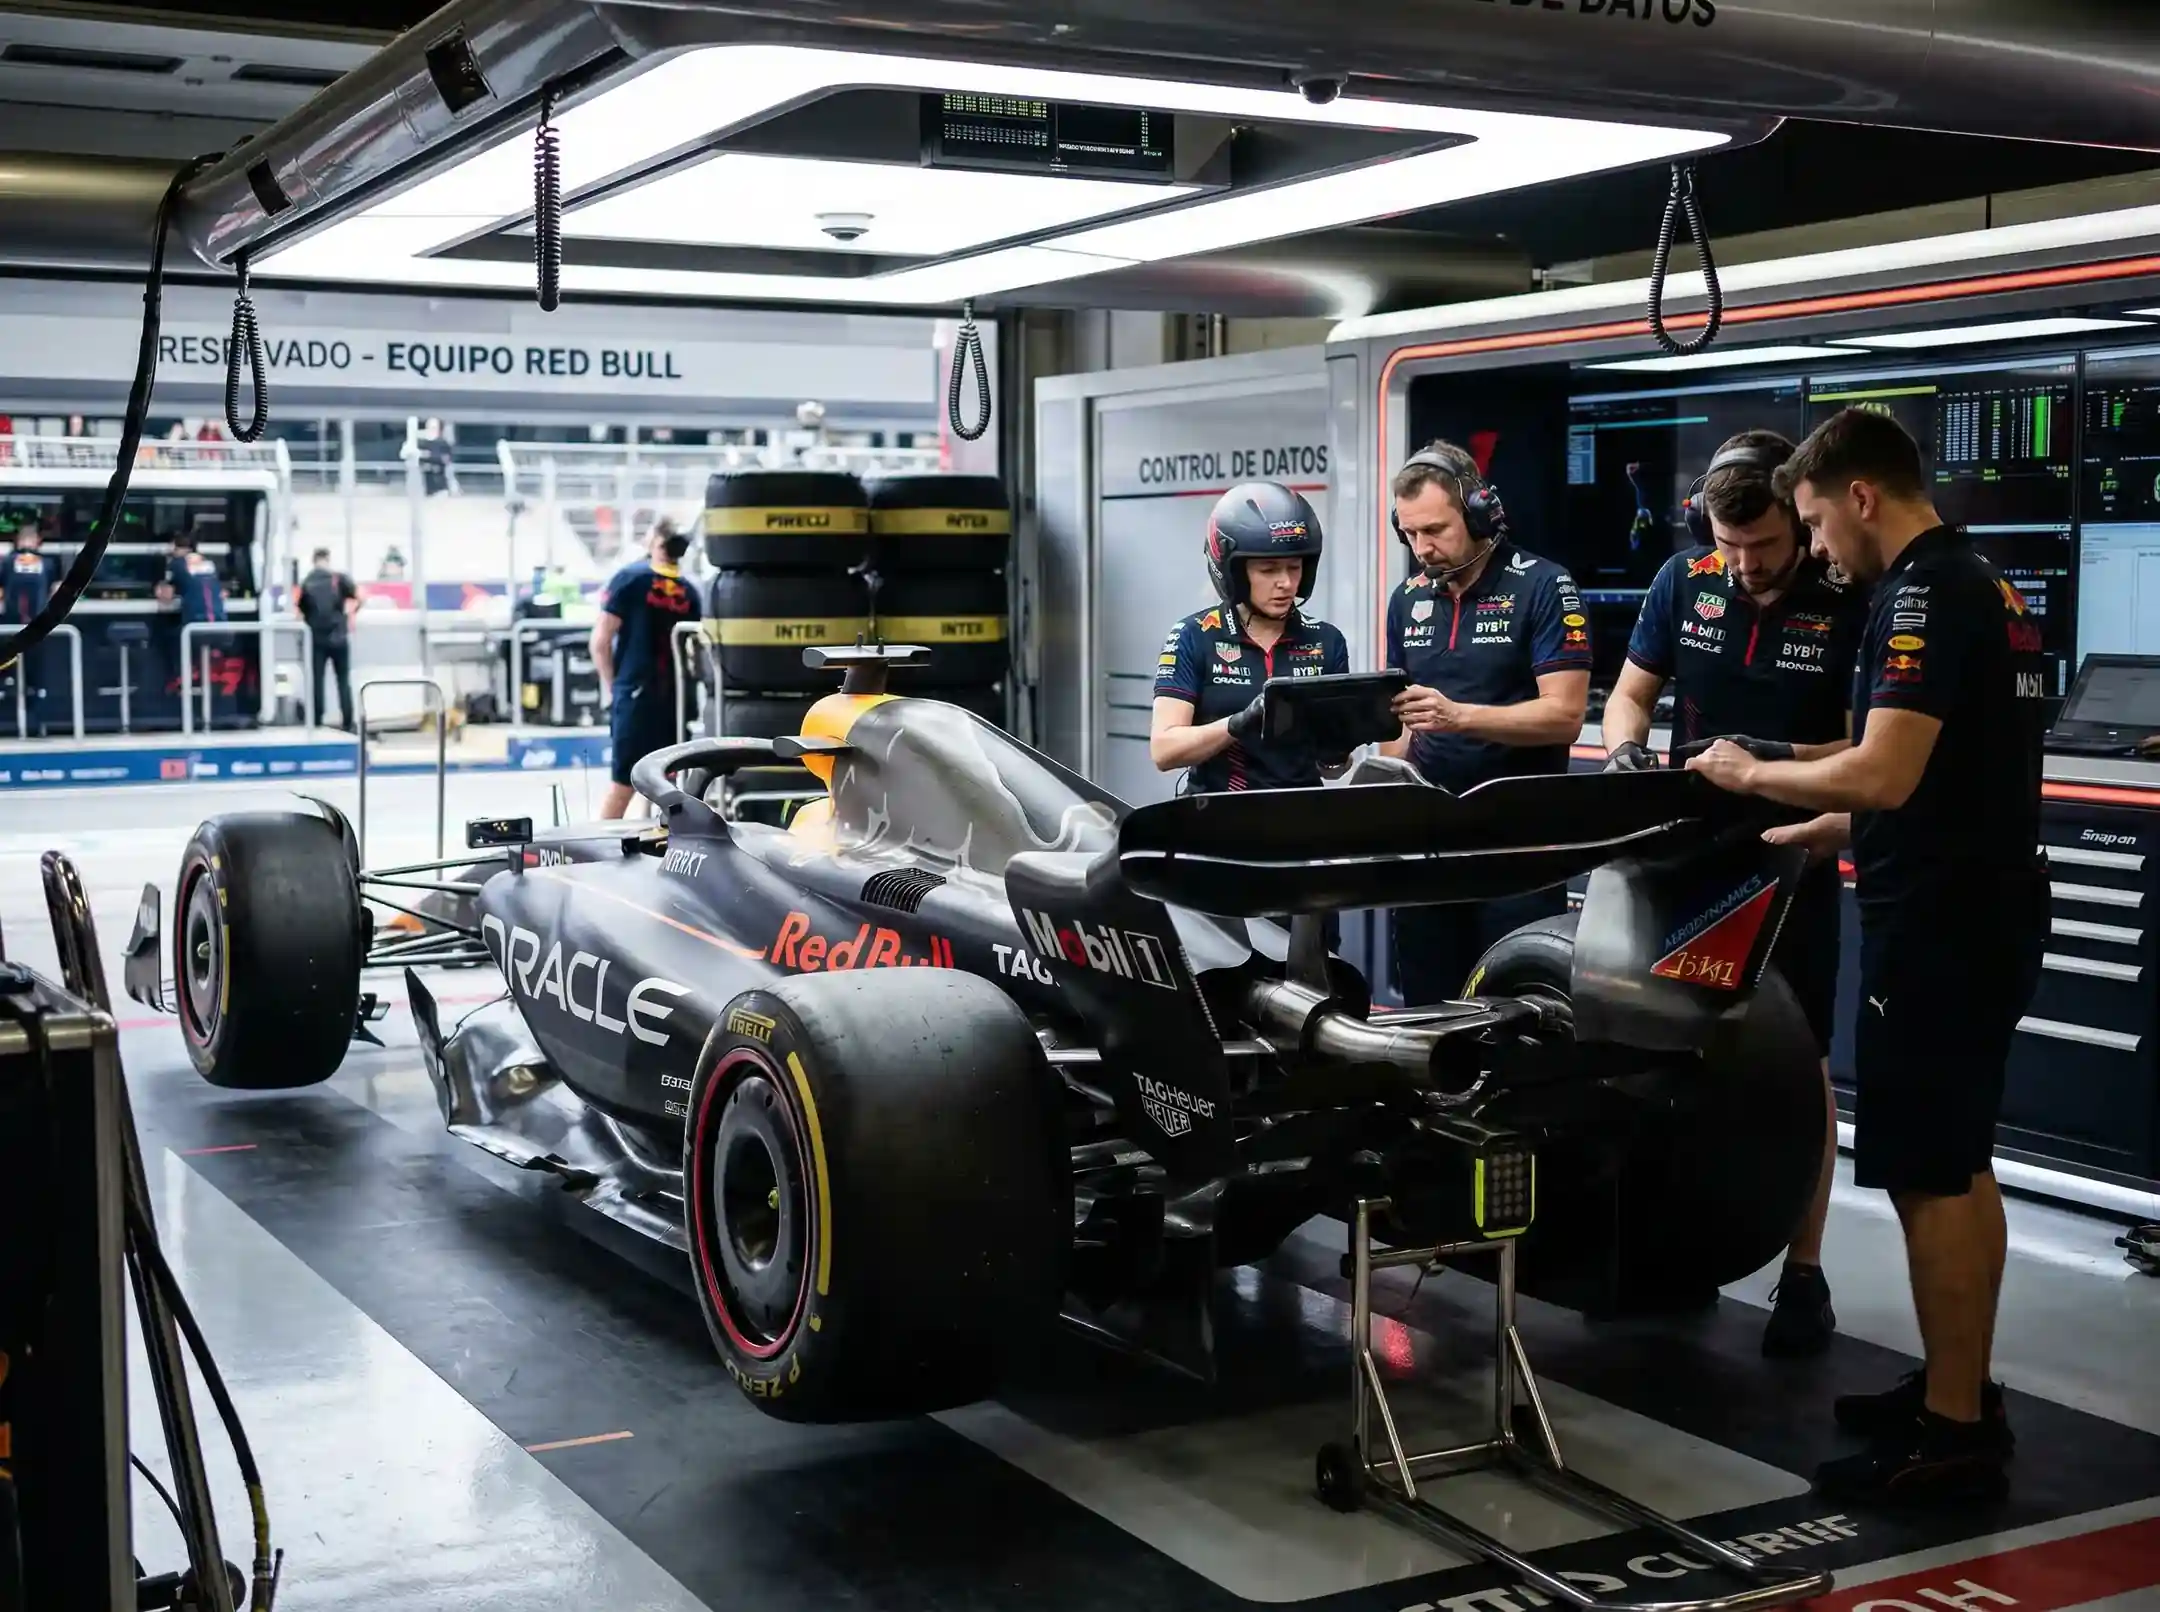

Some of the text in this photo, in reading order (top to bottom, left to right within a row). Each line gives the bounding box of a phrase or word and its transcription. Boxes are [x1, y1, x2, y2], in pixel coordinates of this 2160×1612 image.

[159, 335, 351, 369] RESVADO
[388, 343, 513, 377] EQUIPO
[525, 347, 590, 375] RED
[601, 349, 682, 378] BULL
[1139, 445, 1328, 483] CONTROL DE DATOS
[775, 624, 826, 638] INTER
[941, 621, 984, 636] INTER
[1776, 660, 1824, 673] HONDA
[1783, 642, 1825, 660] BYBIT
[770, 911, 870, 972] Red
[1022, 907, 1134, 980] Mobil
[481, 913, 693, 1047] ORACLE
[727, 1007, 776, 1044] PIRELLI
[1145, 1098, 1189, 1134] HEUER
